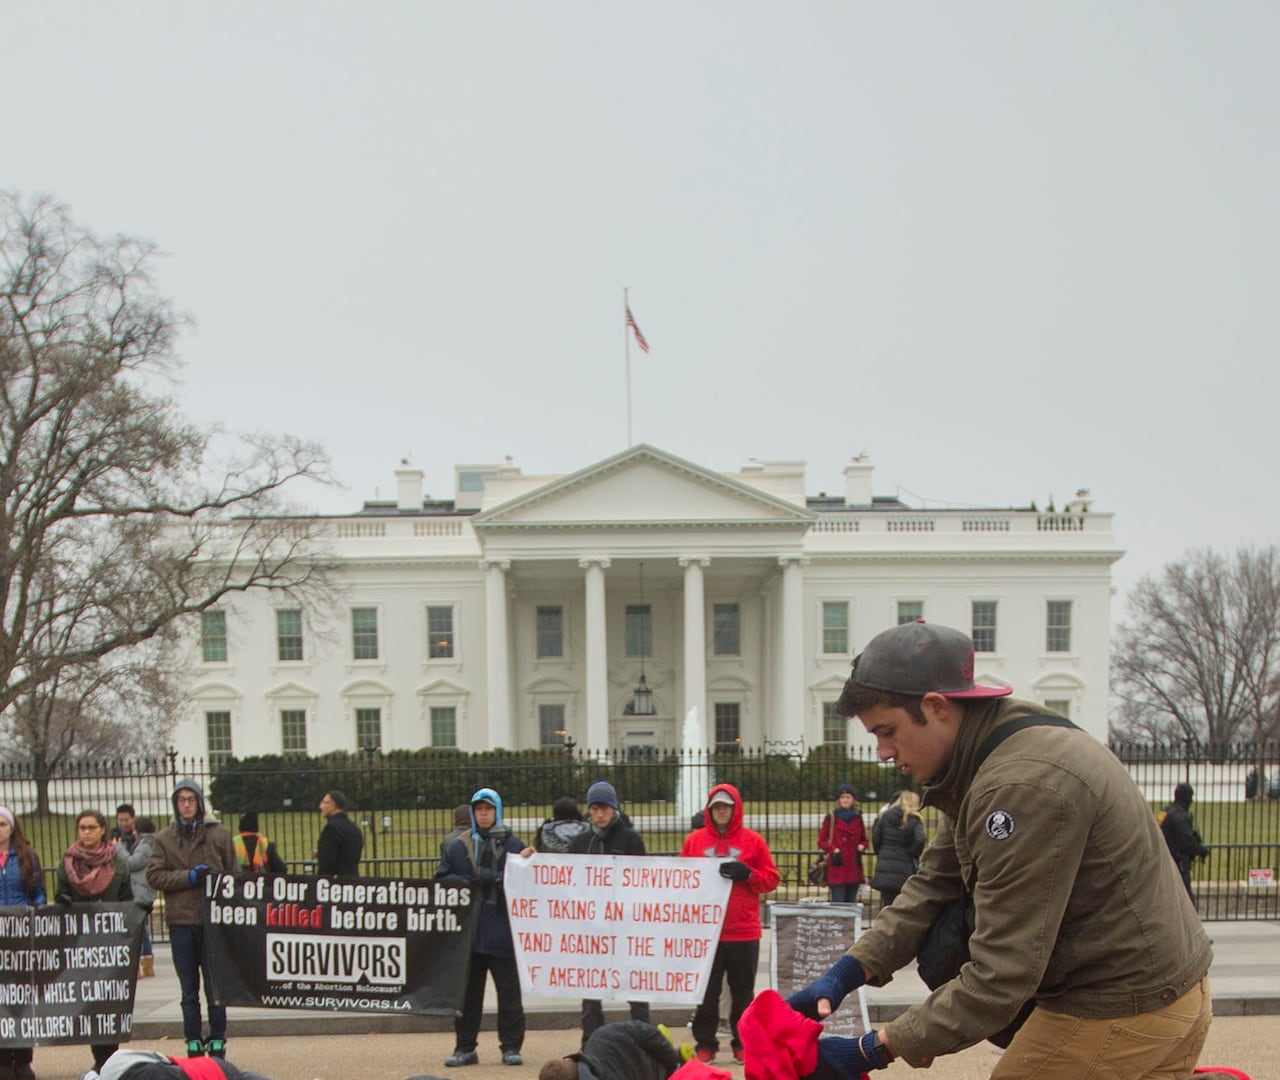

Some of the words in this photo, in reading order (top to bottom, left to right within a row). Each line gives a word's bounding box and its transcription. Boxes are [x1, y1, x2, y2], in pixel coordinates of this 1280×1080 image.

[205, 873, 235, 899] 1/3
[243, 876, 265, 900] of
[273, 877, 308, 901] Our
[316, 878, 429, 905] Generation
[434, 882, 471, 906] has
[532, 865, 576, 887] TODAY,
[586, 866, 613, 886] THE
[622, 868, 701, 889] SURVIVORS
[210, 901, 257, 925] been
[266, 902, 322, 928] killed
[331, 905, 398, 930] before
[407, 907, 462, 932] birth.
[512, 898, 539, 918] ARE
[547, 899, 596, 921] TAKING
[604, 901, 624, 922] AN
[633, 902, 722, 924] UNASHAMED
[35, 915, 60, 937] DOWN
[64, 913, 77, 935] IN
[82, 913, 90, 934] A
[95, 912, 128, 934] FETAL
[517, 932, 552, 953] TAND
[560, 934, 618, 955] AGAINST
[627, 936, 655, 956] THE
[64, 945, 130, 969] THEMSELVES
[272, 940, 401, 978] SURVIVORS
[43, 981, 76, 1004] WHILE
[81, 979, 130, 1001] CLAIMING
[549, 966, 620, 990] AMERICA'S
[629, 970, 699, 992] CHILDRE
[261, 995, 412, 1010] WWW.SURVIVORS.LA
[21, 1016, 74, 1038] CHILDREN
[79, 1014, 92, 1037] IN
[96, 1013, 117, 1035] THE
